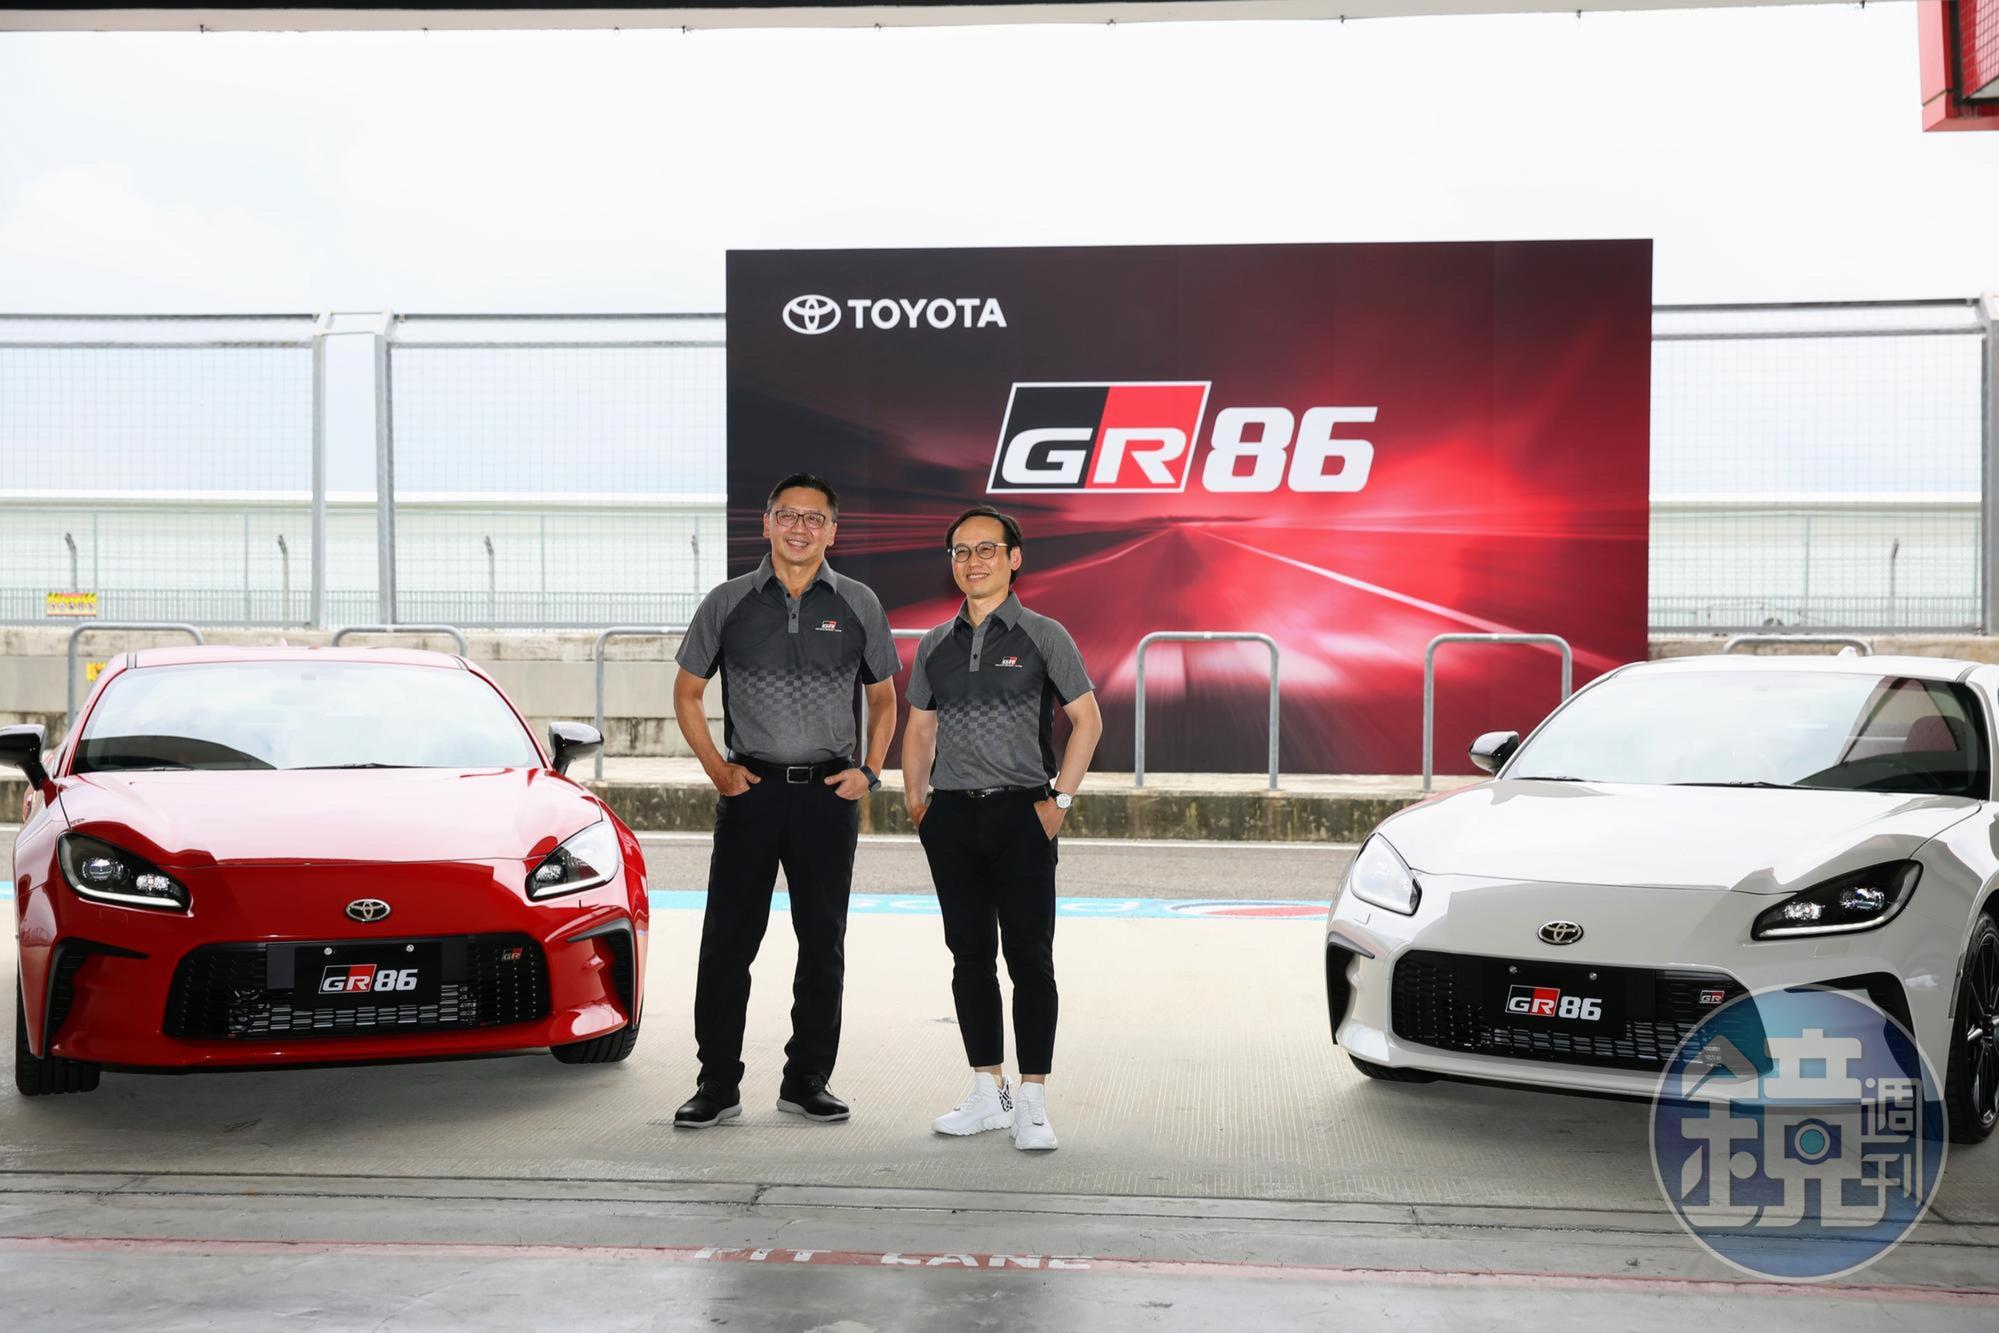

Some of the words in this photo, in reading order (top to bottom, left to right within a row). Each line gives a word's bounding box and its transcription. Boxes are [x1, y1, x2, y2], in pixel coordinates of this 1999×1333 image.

[848, 298, 1007, 330] TOYOTA
[502, 950, 522, 961] GR
[1700, 992, 1723, 1003] GR
